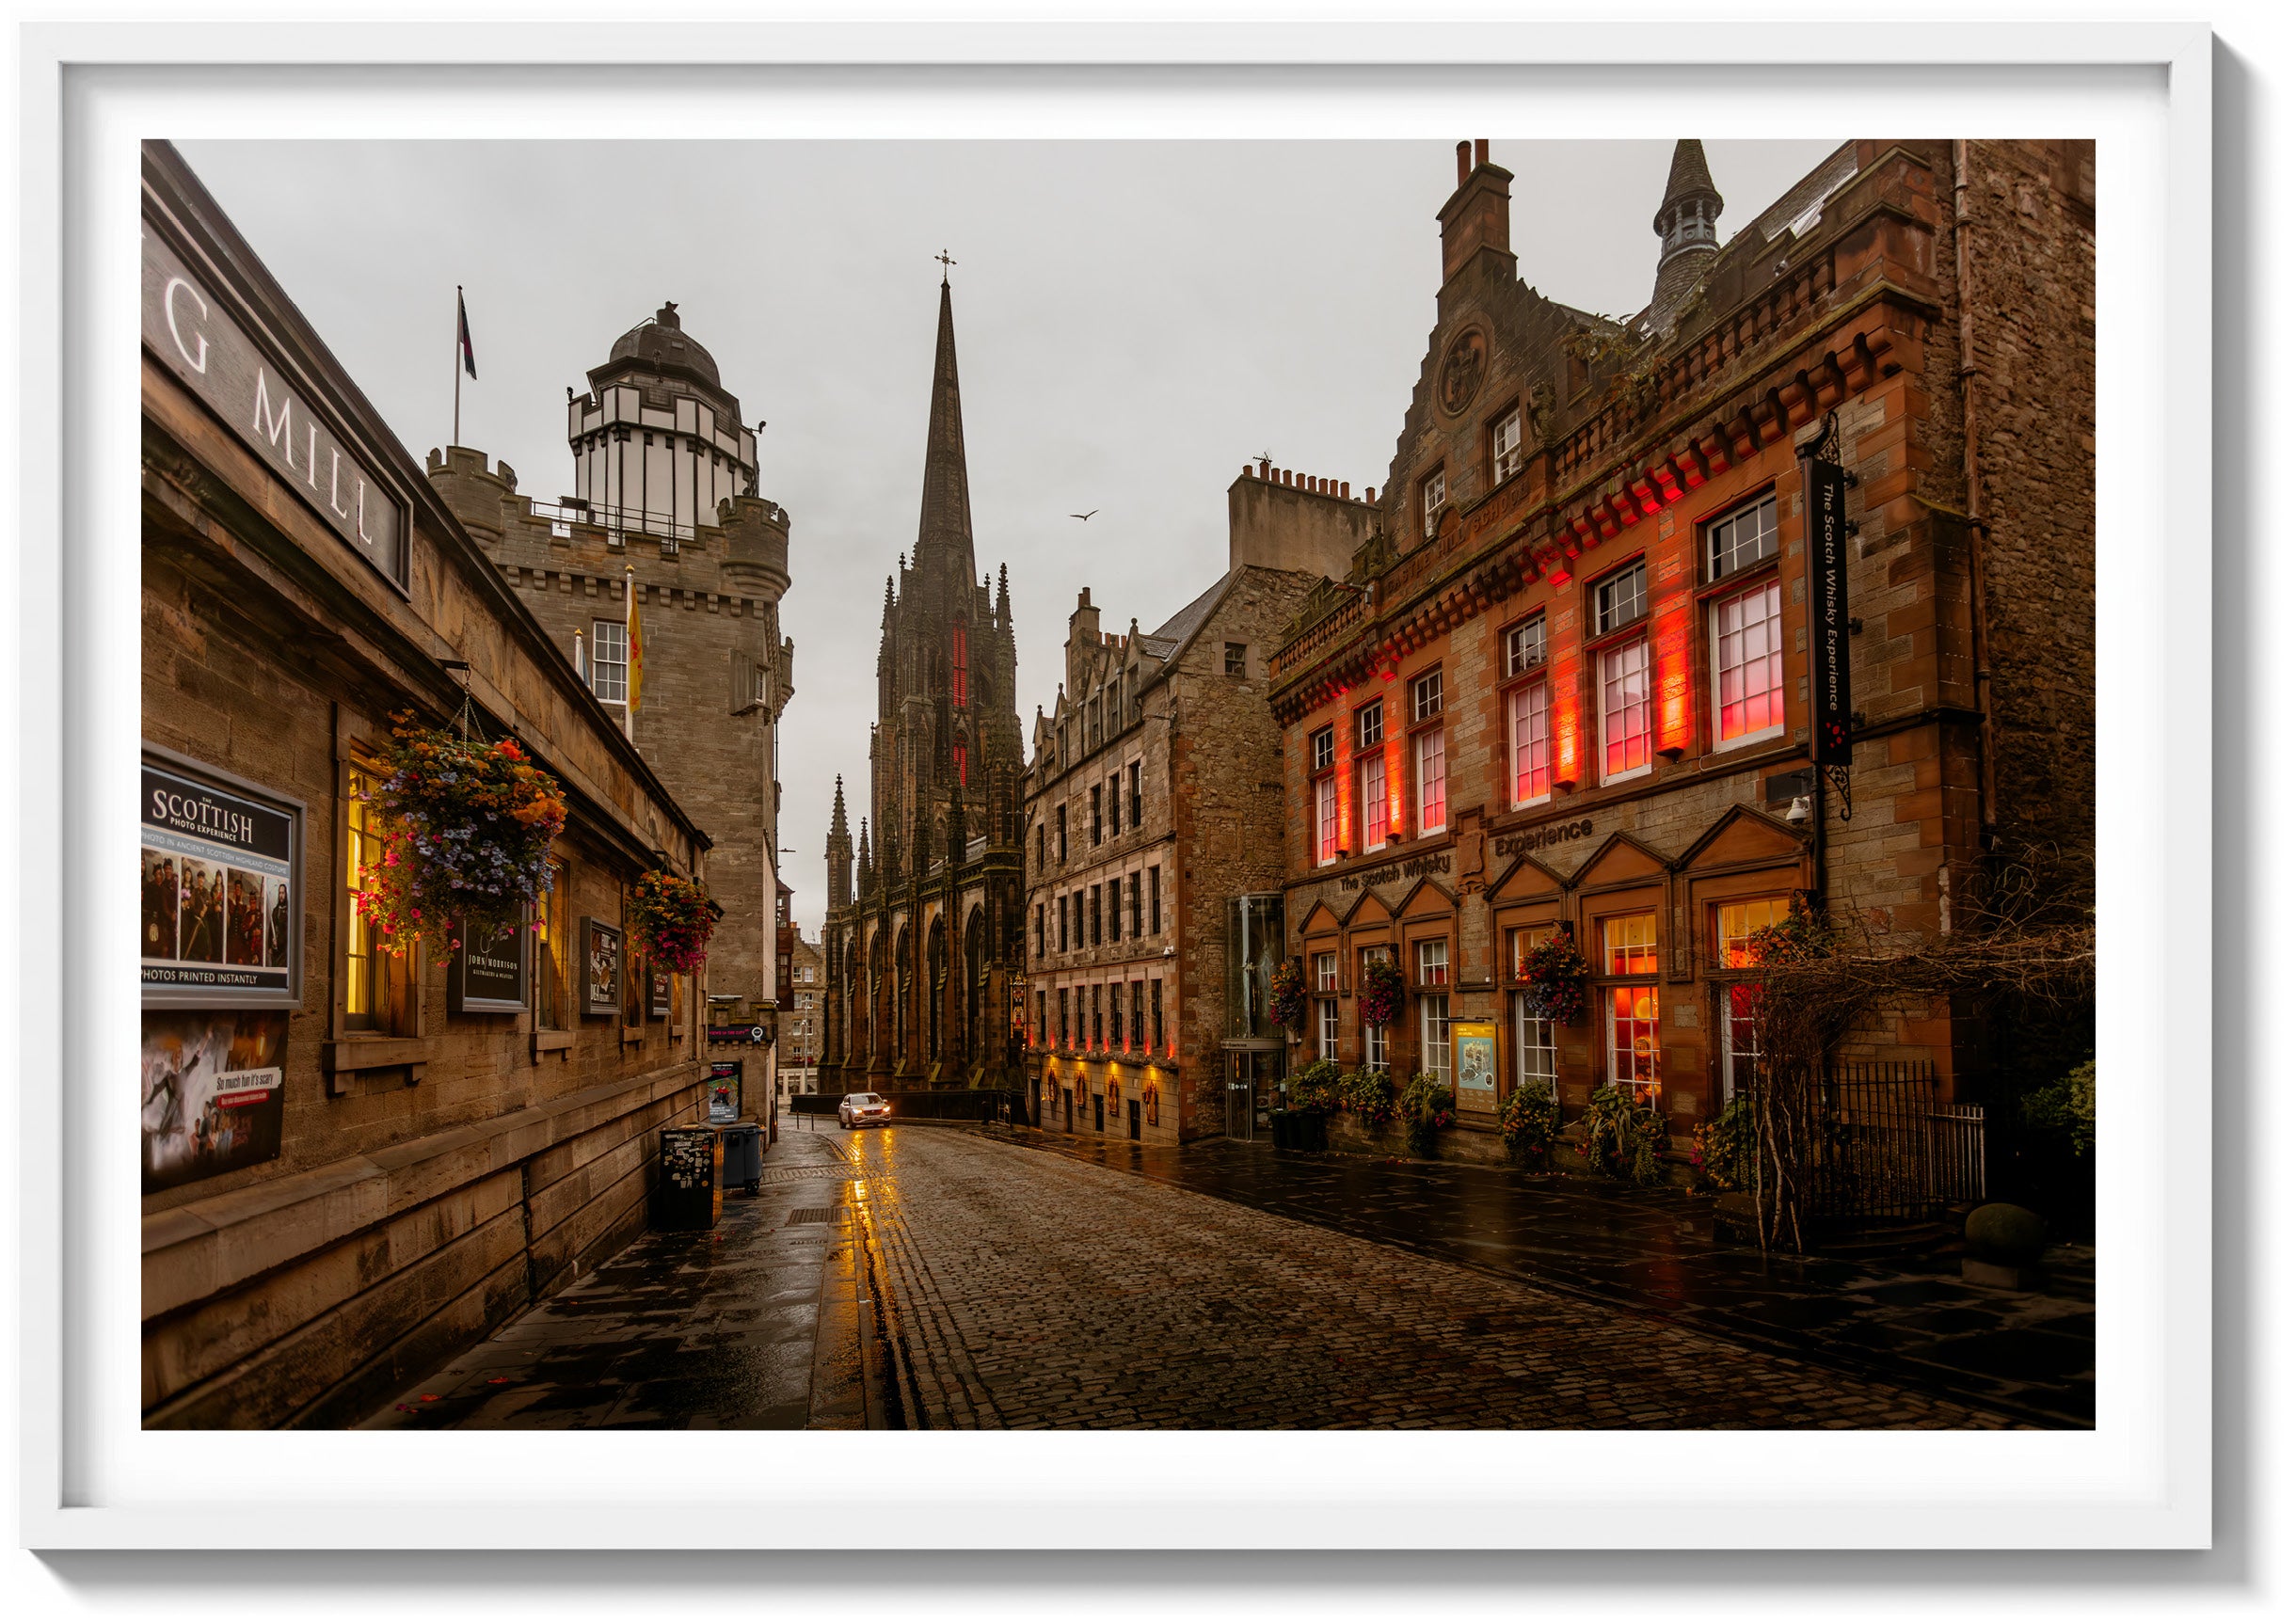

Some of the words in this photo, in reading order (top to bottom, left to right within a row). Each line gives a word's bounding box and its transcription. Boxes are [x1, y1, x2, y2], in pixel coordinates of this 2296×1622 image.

[252, 367, 374, 545] MILL
[1823, 483, 1834, 512] The
[1438, 529, 1466, 559] HILL
[1824, 513, 1836, 565] Scotch
[1825, 568, 1837, 626] Whisky
[1826, 628, 1839, 711] Experience
[202, 796, 213, 804] THE
[151, 788, 254, 845] SCOTTISH
[169, 816, 195, 830] PHOTO
[197, 825, 237, 842] EXPERIENCE
[167, 837, 175, 847] IN
[177, 840, 205, 853] ANCIENT
[207, 848, 234, 862] SCOTTISH
[1340, 877, 1359, 892] The
[1361, 865, 1400, 887] Scotch
[1402, 853, 1452, 877] Whisky
[1494, 818, 1594, 857] Experience
[141, 969, 176, 980] PHOTOS
[179, 971, 215, 982] PRINTED
[217, 973, 258, 984] INSTANTLY
[469, 954, 486, 965] JOHN
[487, 958, 518, 970] MORRISON
[216, 1076, 225, 1090] So
[225, 1075, 241, 1089] much
[241, 1074, 250, 1088] fun
[259, 1073, 274, 1085] scary
